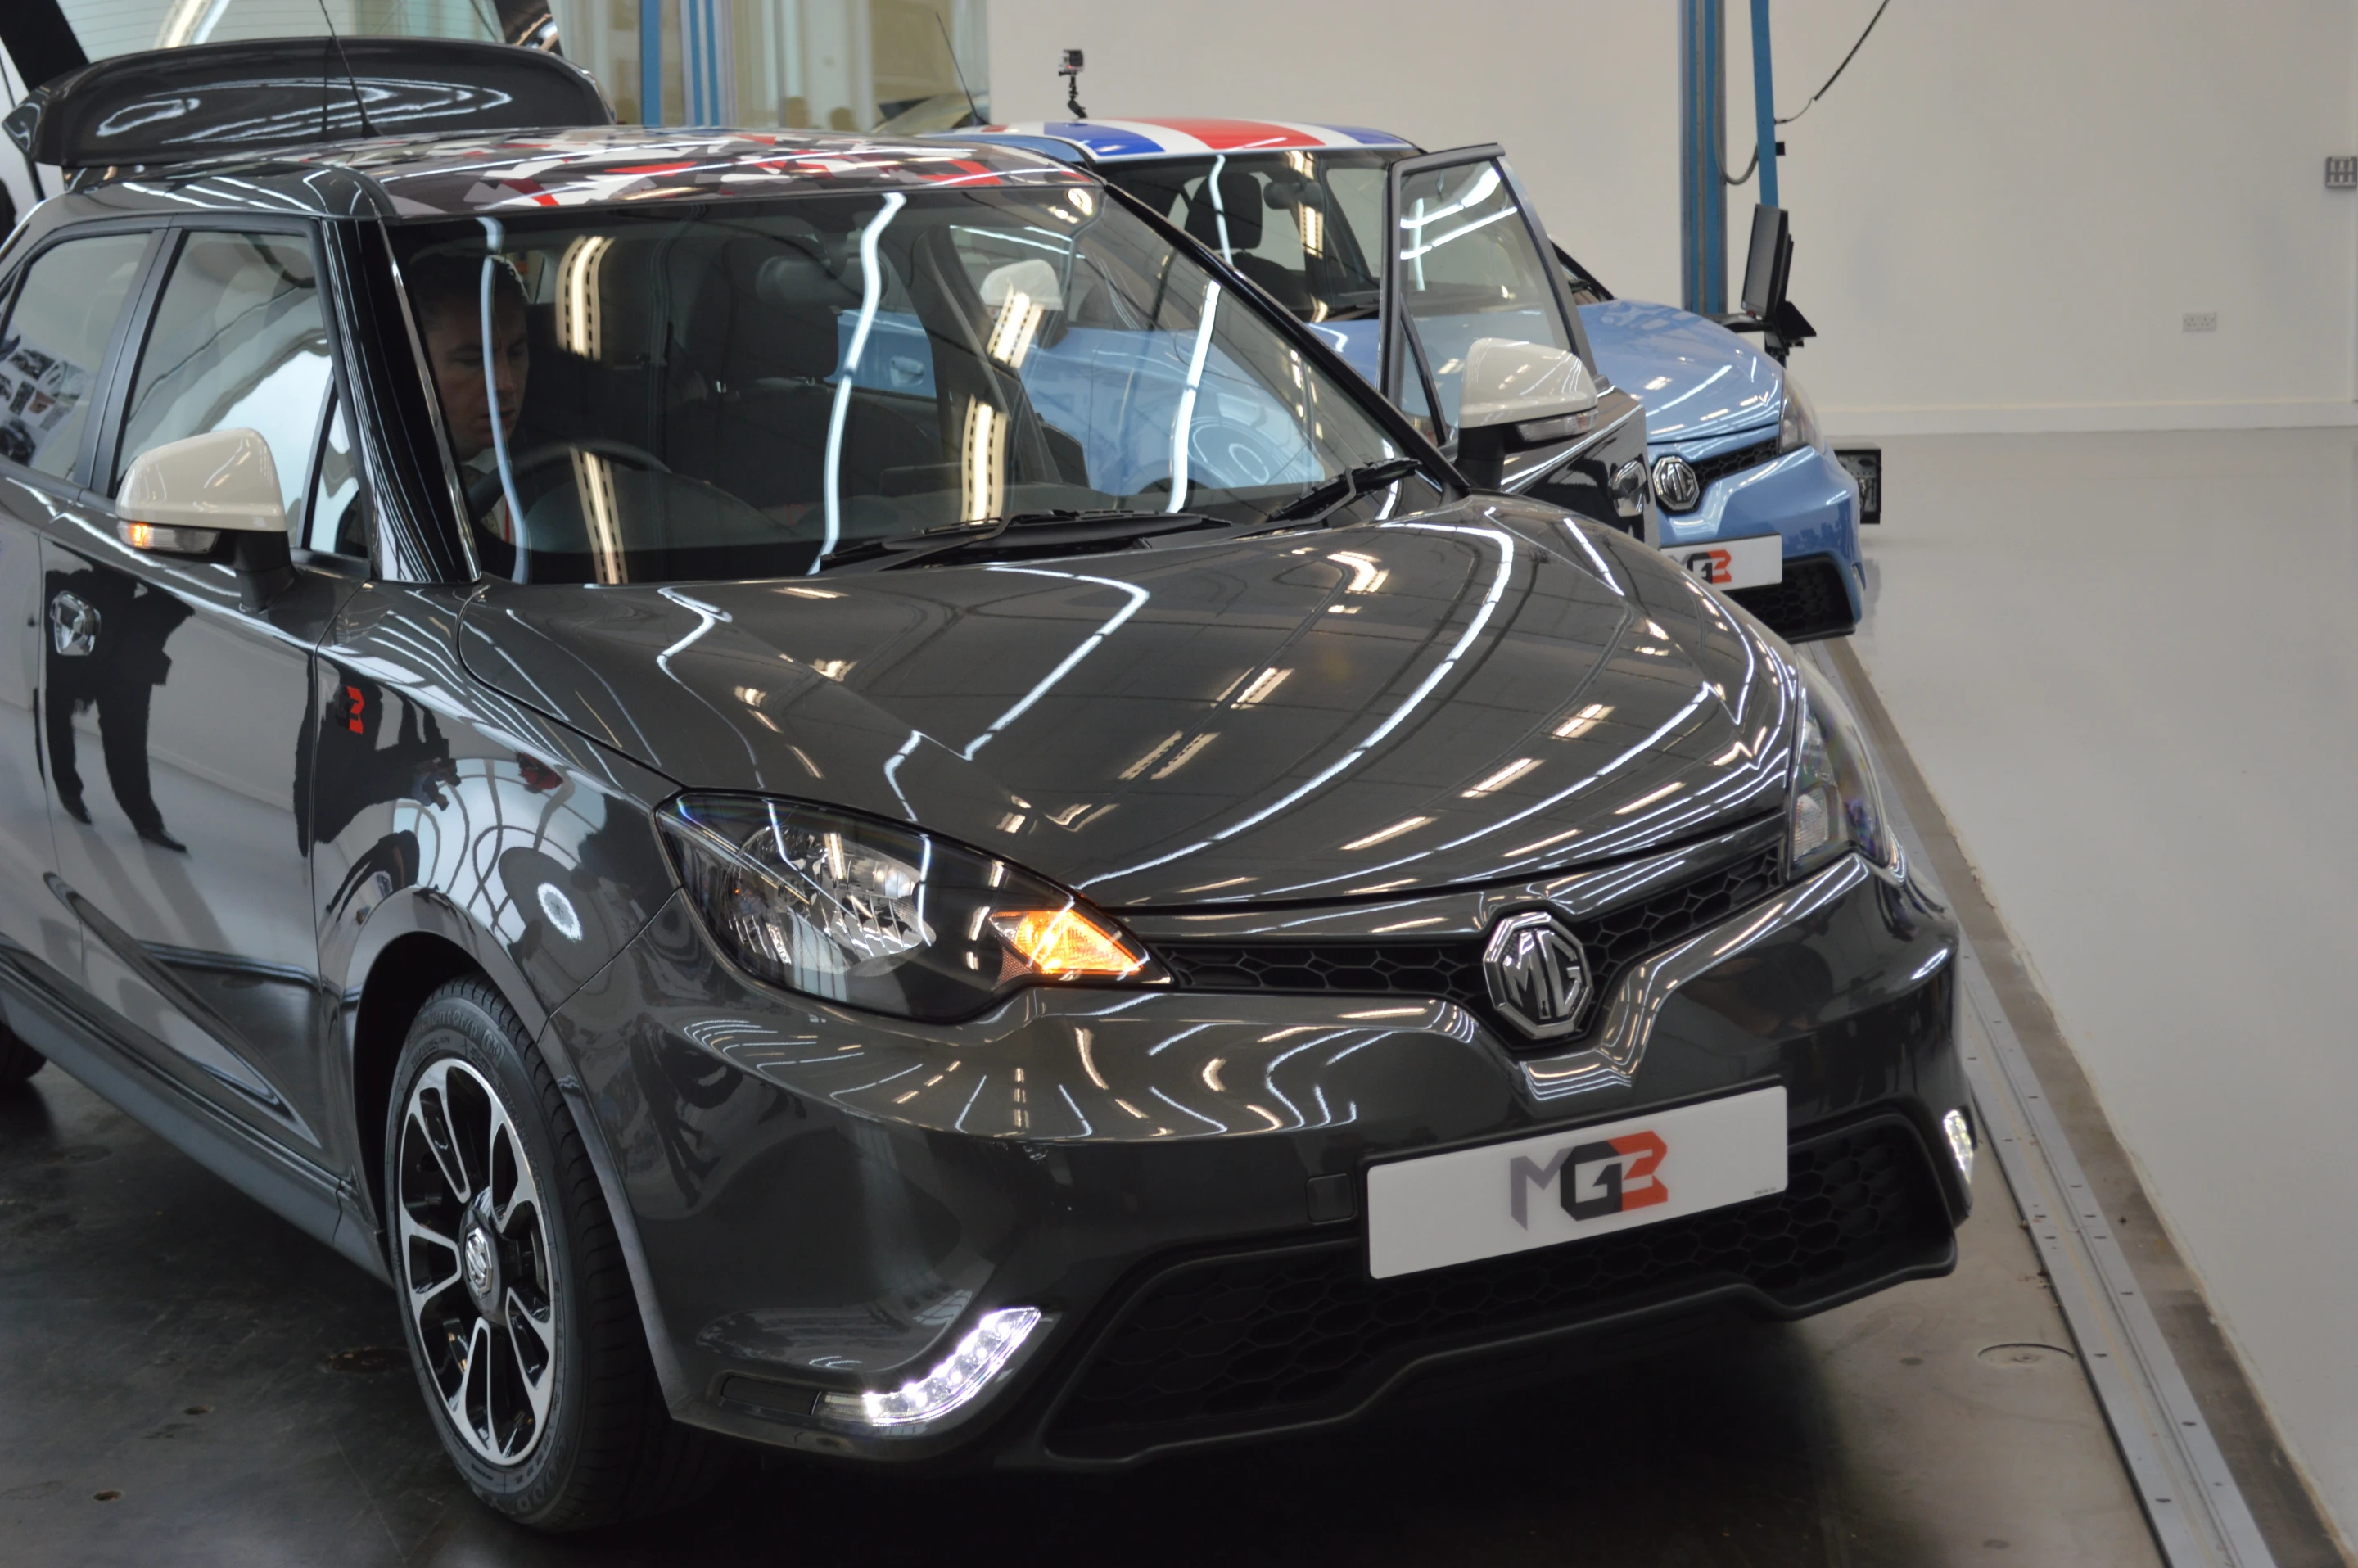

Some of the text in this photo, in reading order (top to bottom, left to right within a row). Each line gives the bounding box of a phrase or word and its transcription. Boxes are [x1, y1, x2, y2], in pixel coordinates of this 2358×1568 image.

[1661, 463, 1695, 502] MG
[1502, 929, 1583, 1020] MG
[408, 1008, 478, 1045] icientGrip
[1510, 1130, 1669, 1231] MG3
